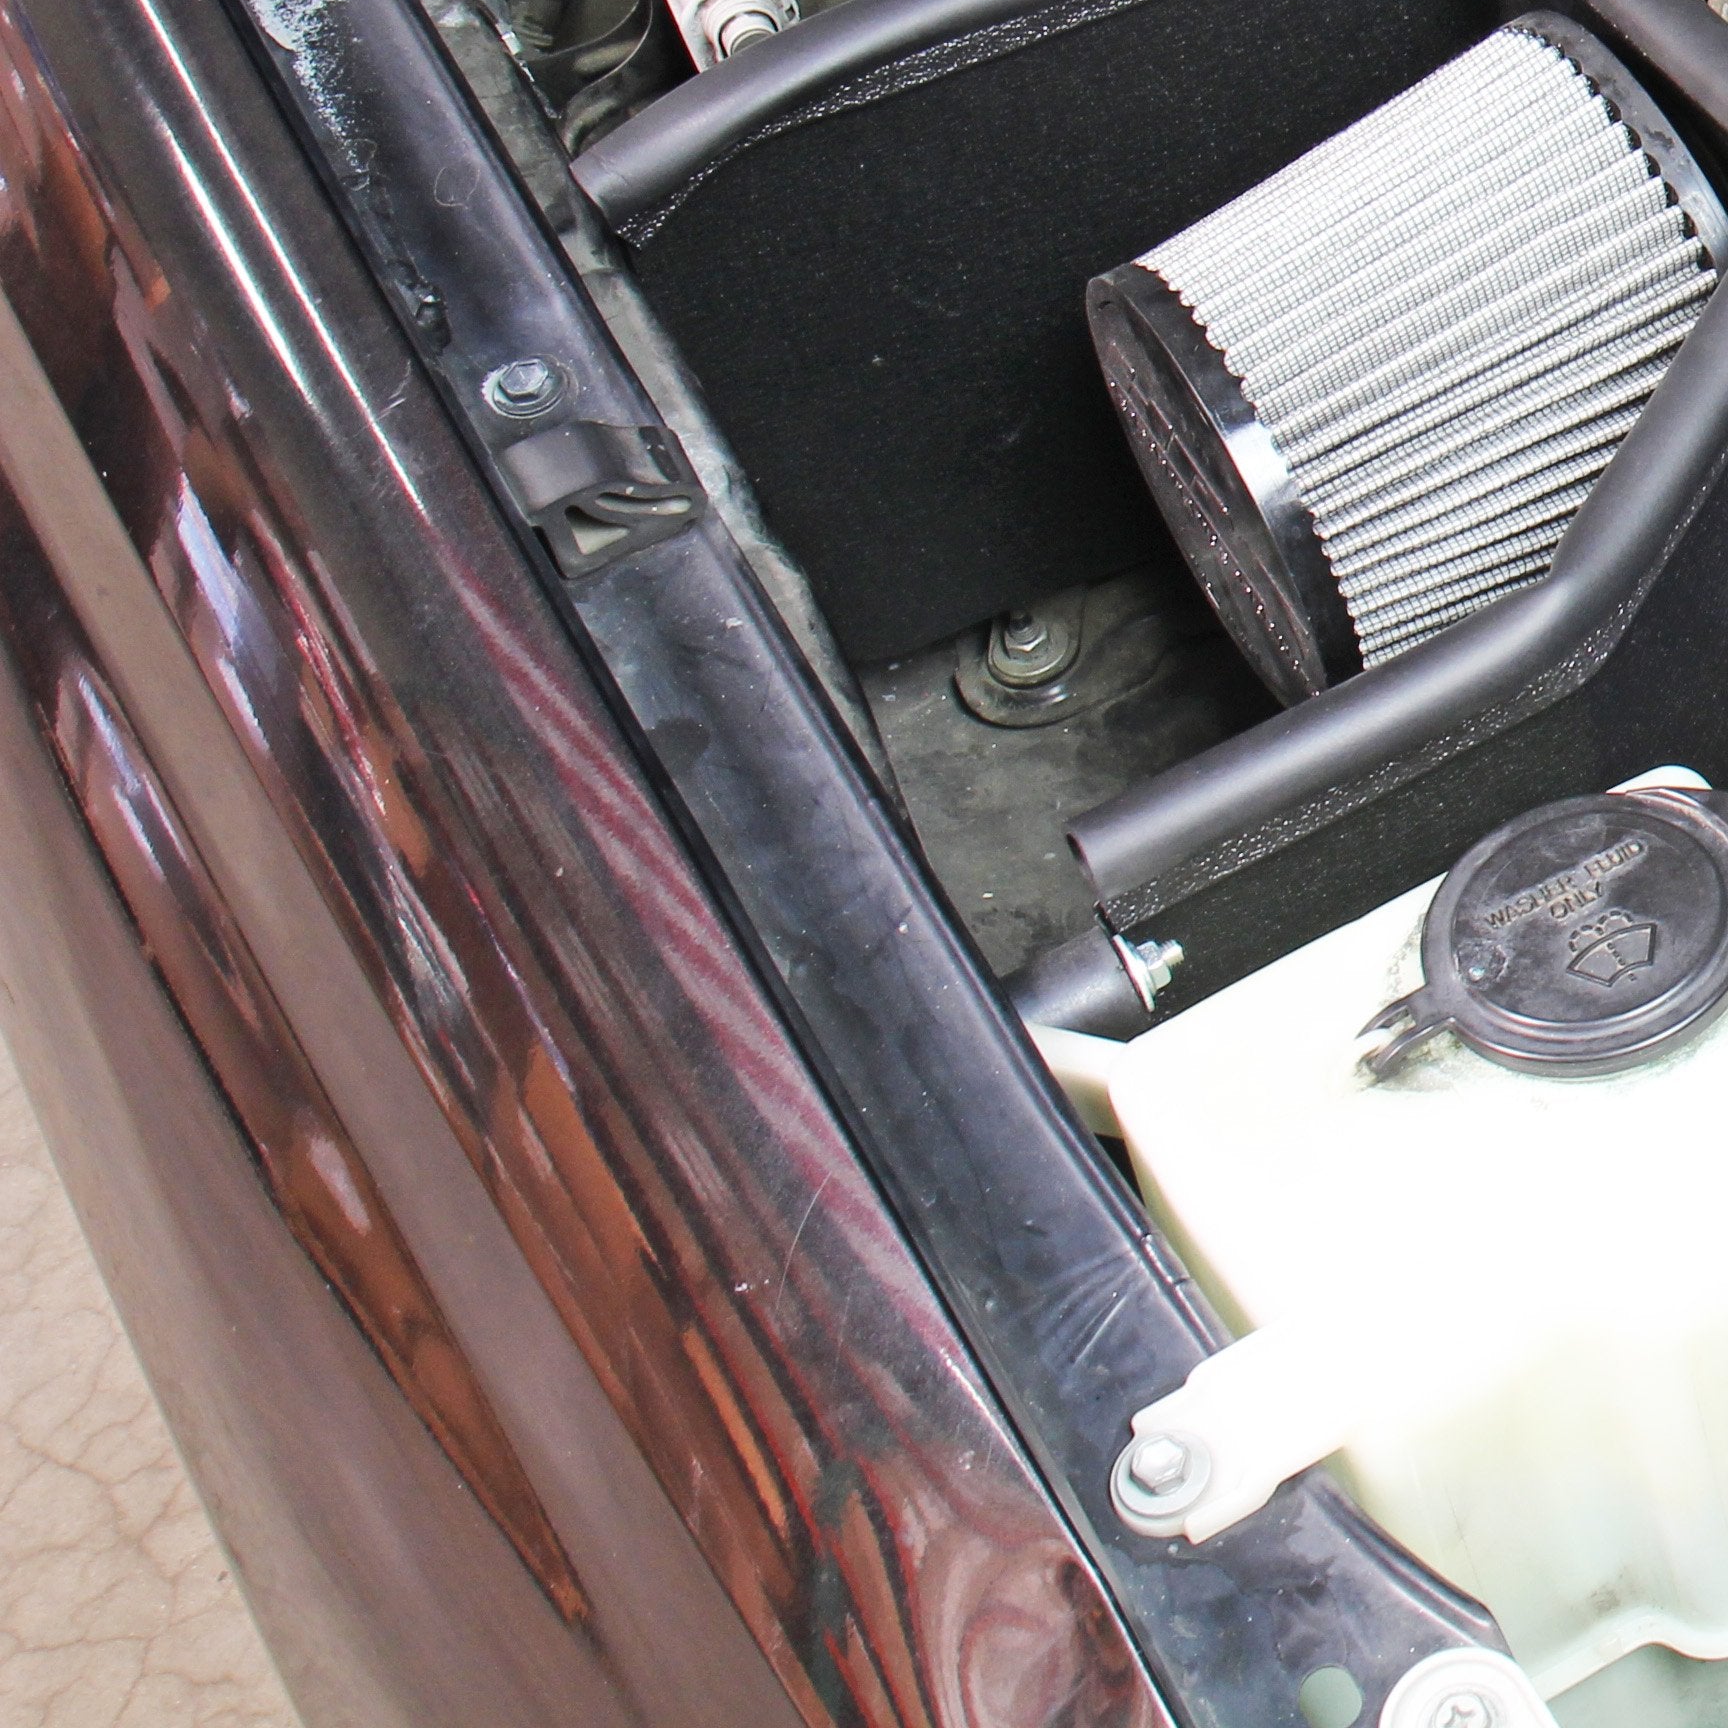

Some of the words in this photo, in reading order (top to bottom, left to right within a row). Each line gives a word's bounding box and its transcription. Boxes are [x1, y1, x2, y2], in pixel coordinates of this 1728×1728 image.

[1484, 872, 1577, 931] WASHER
[1583, 839, 1648, 878] FLUID
[1549, 881, 1607, 921] ONLY
